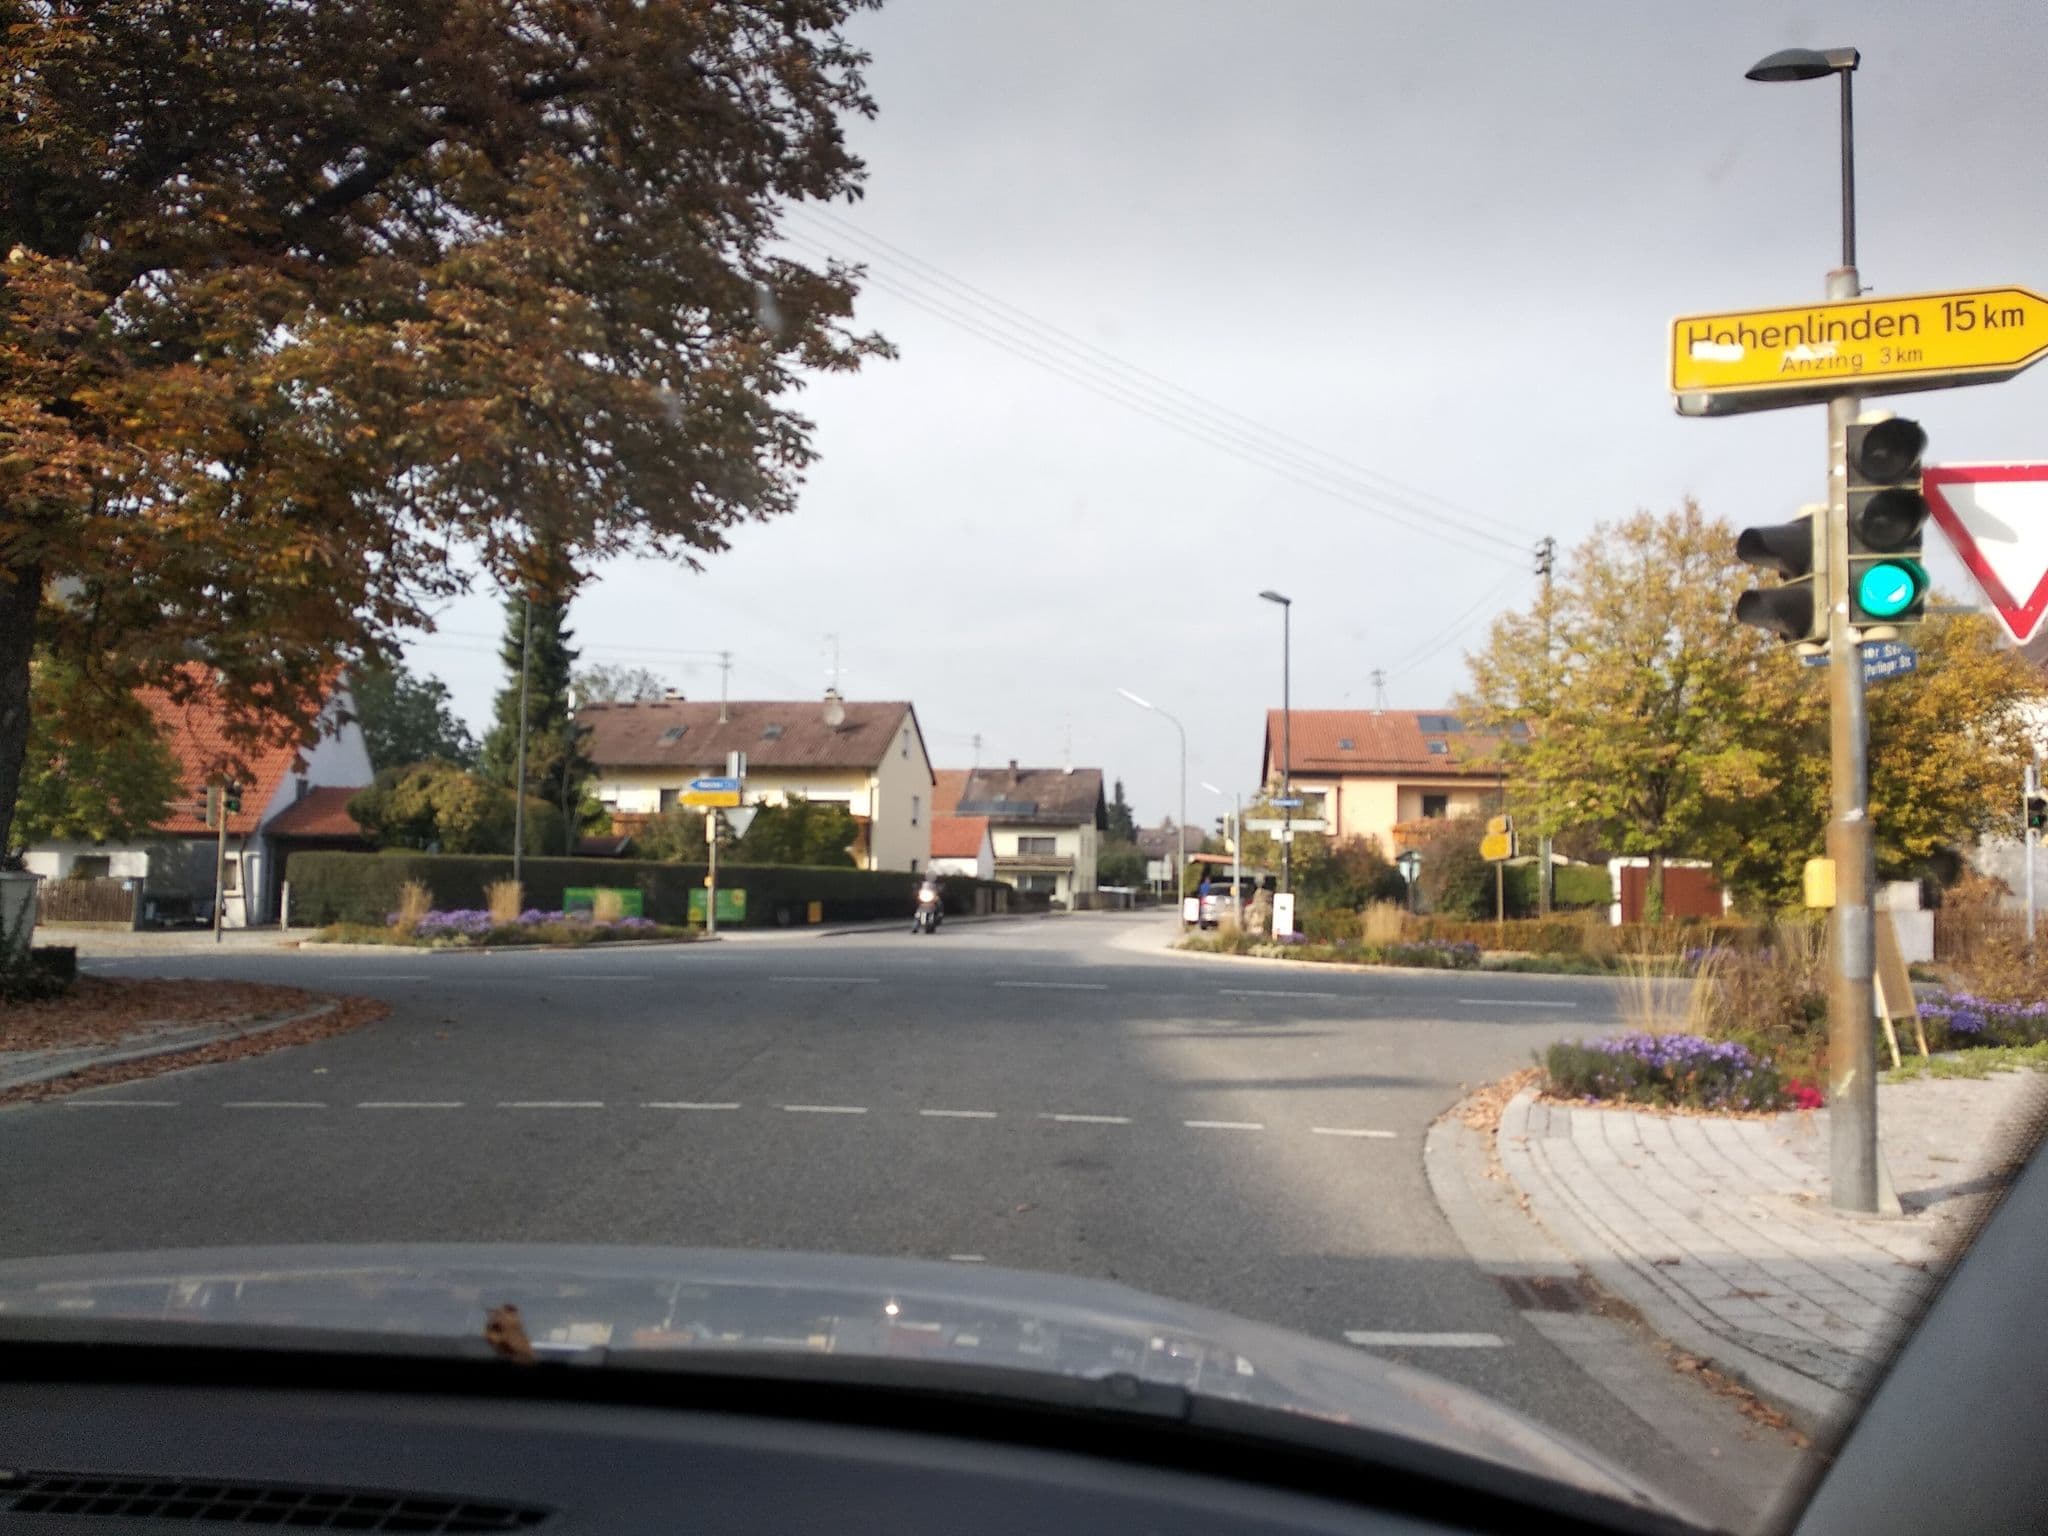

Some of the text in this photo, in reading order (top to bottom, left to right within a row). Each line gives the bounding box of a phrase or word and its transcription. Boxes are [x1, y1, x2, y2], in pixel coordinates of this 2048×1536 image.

[1688, 300, 2024, 355] Hohenlinden 15 km
[1781, 347, 1923, 372] Anzing 3 km
